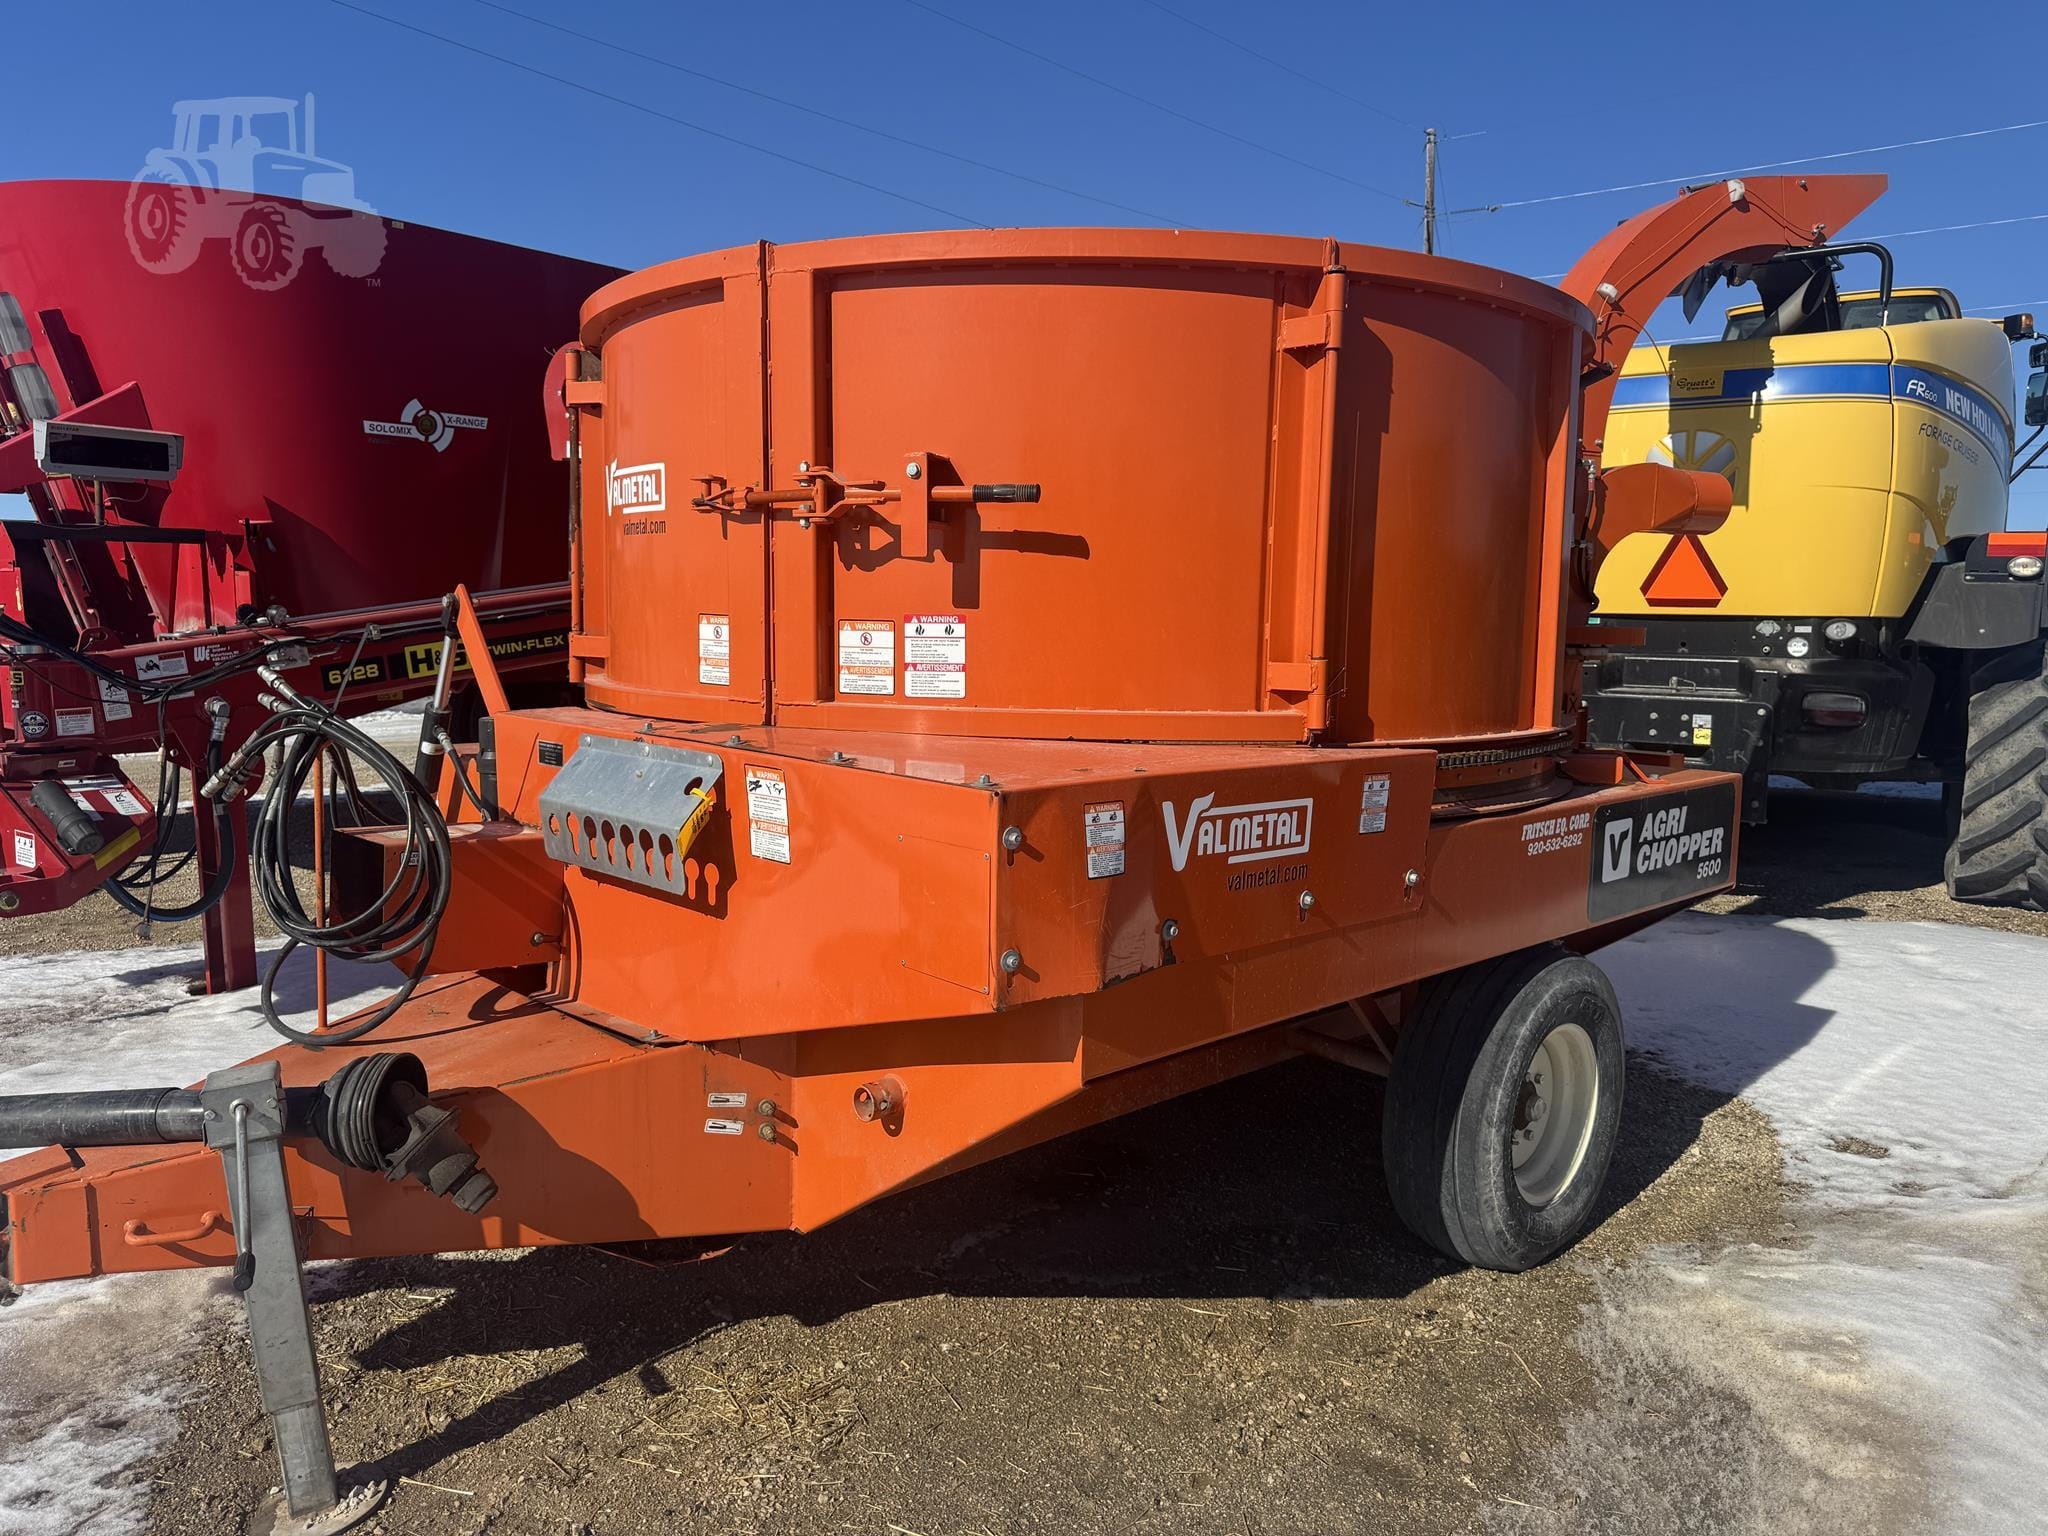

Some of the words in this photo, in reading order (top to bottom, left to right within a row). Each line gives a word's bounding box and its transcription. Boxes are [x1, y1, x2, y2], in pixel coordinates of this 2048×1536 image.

[1906, 379, 1937, 402] FR600
[1945, 387, 1970, 421] NEW
[368, 423, 413, 436] SOLOMIX
[447, 416, 486, 428] X-RANGE
[1918, 423, 1953, 447] FORAGE
[605, 458, 664, 517] VALMETAL
[623, 518, 666, 535] valmetal.com
[855, 623, 890, 631] WARNING
[919, 615, 959, 624] WARNING
[488, 635, 565, 656] WIN-FLEX
[916, 663, 964, 672] AVERTISSEMENT
[1162, 791, 1303, 872] VALMETAL
[1521, 819, 1557, 841] FRITSCH
[1555, 816, 1568, 836] EQ.
[1569, 812, 1590, 831] CORP.
[1638, 805, 1688, 843] AGRI
[1527, 832, 1583, 856] 920-532-6292
[1636, 826, 1725, 875] CHOPPER
[1226, 862, 1309, 893] valmetal.com
[1696, 857, 1722, 880] 5600
